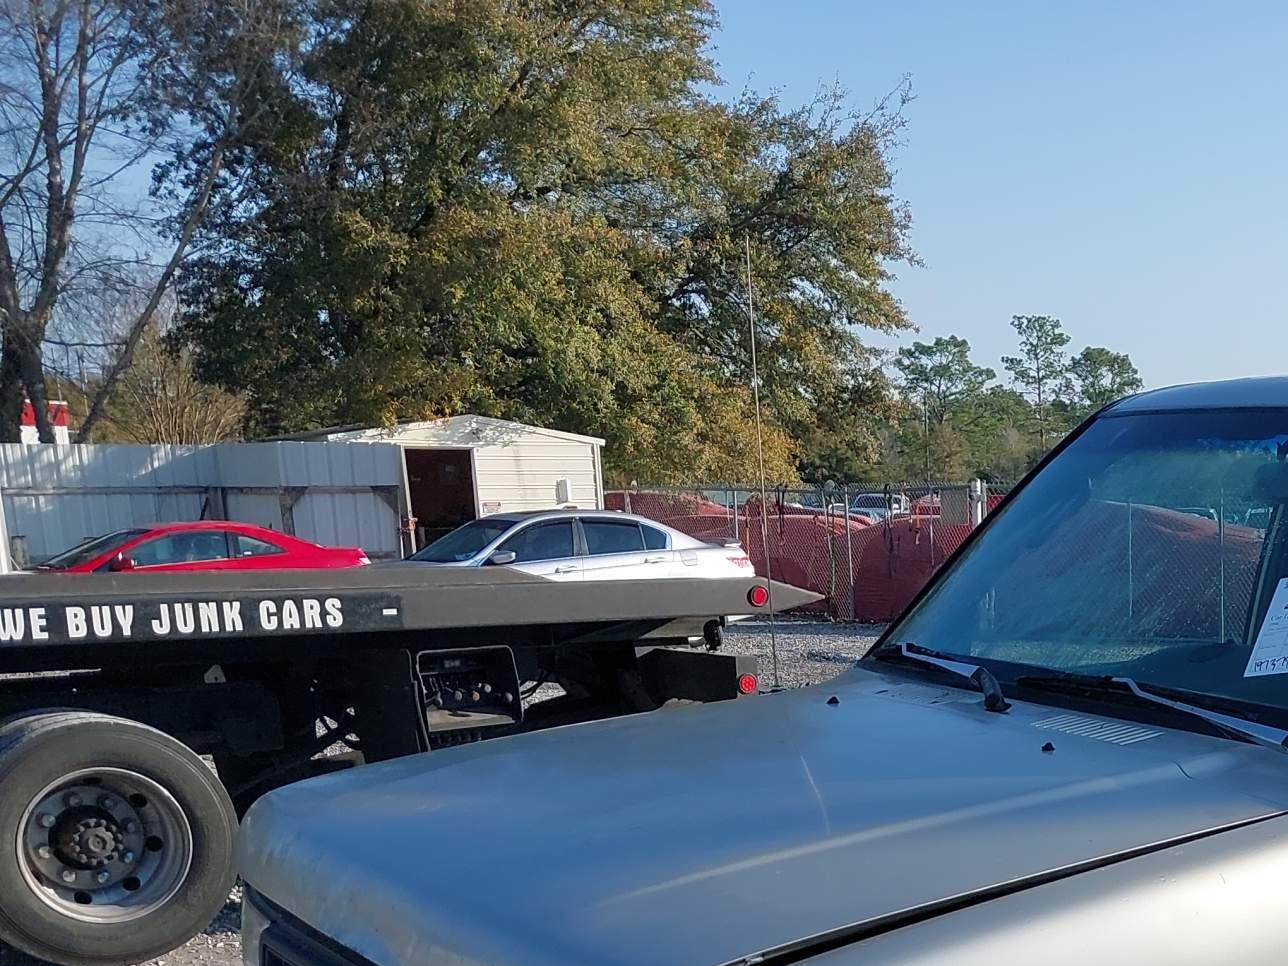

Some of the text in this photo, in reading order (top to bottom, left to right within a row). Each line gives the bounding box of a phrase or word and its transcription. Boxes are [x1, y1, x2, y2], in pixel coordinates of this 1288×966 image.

[0, 607, 49, 641] WE
[66, 605, 134, 638] BUY
[151, 601, 244, 634] JUNK
[259, 598, 344, 630] CARS
